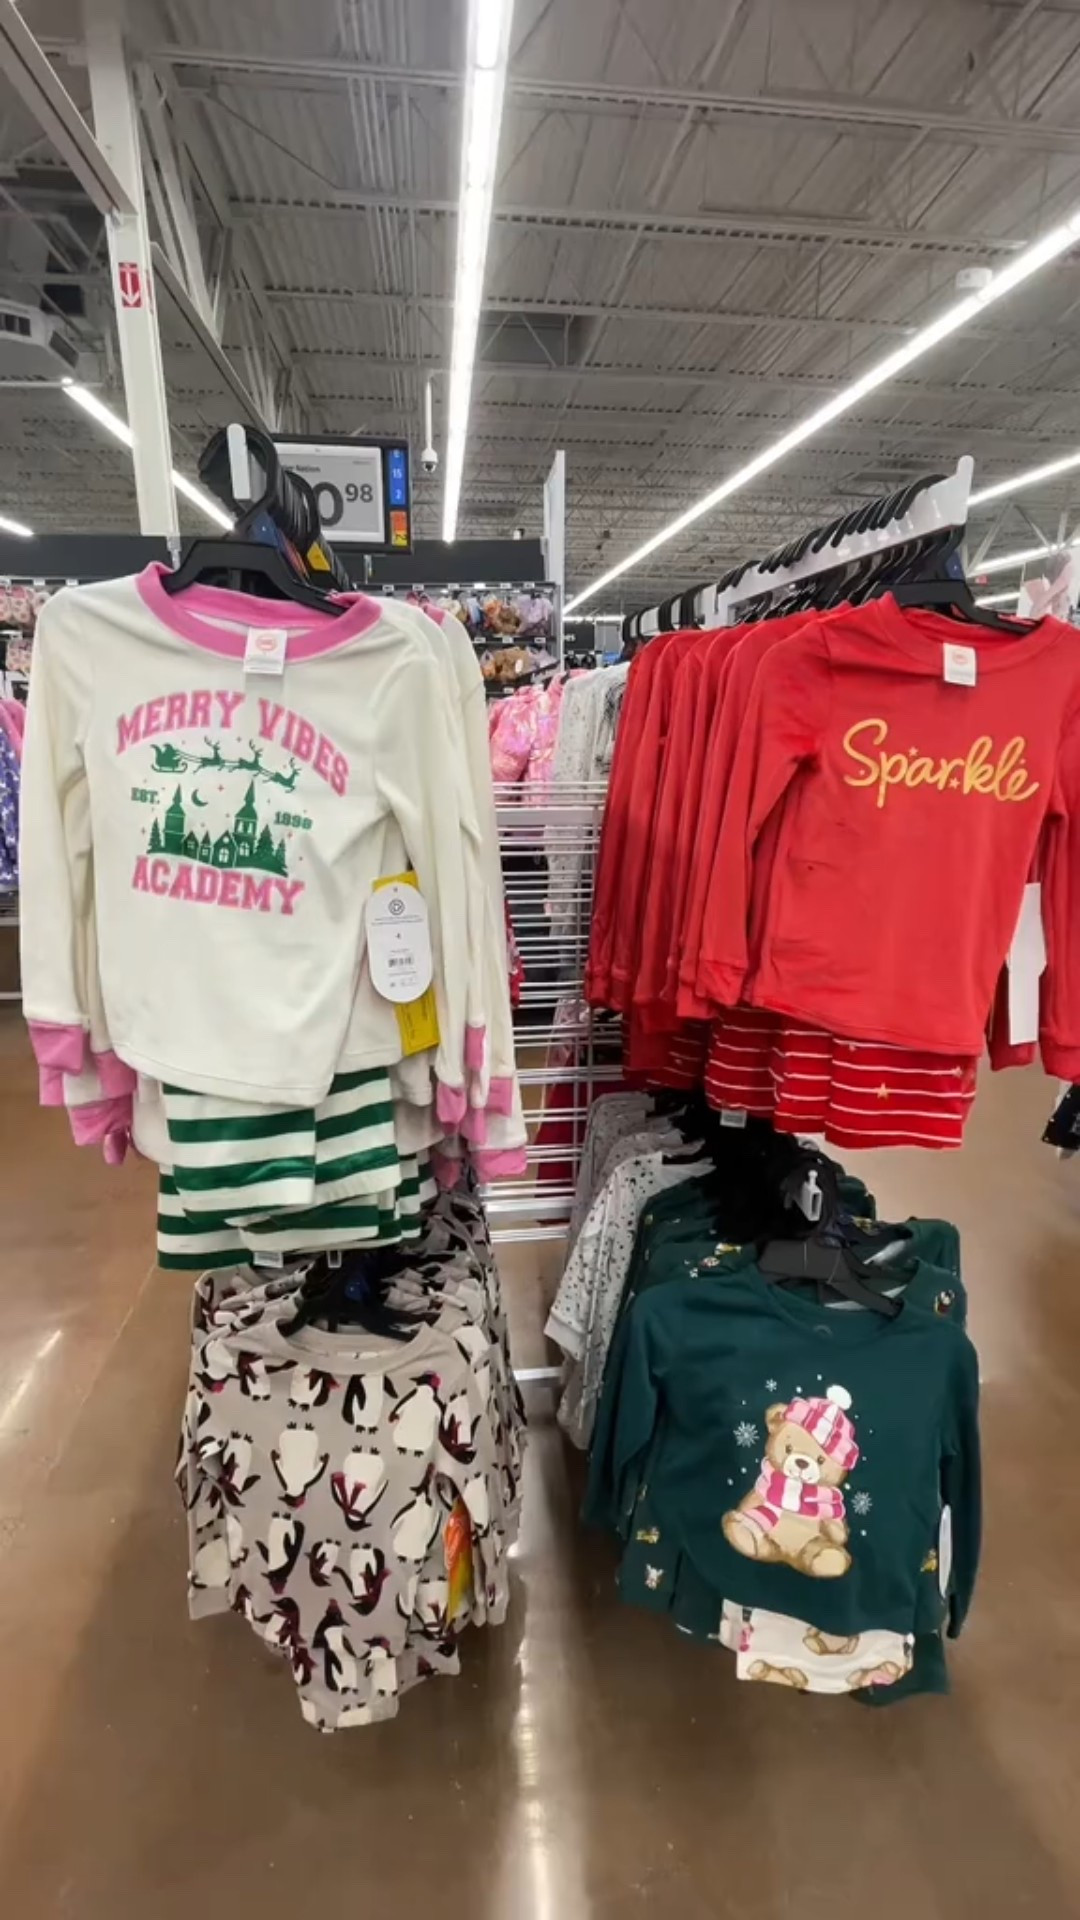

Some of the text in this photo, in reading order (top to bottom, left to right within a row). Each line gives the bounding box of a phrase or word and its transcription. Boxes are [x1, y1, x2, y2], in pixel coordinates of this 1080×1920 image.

[345, 483, 373, 503] 98
[392, 468, 402, 479] 15
[116, 690, 349, 797] MERRY VIBES
[843, 718, 1040, 809] Sparkle
[131, 787, 160, 804] EST.
[132, 855, 305, 916] ACADEMY
